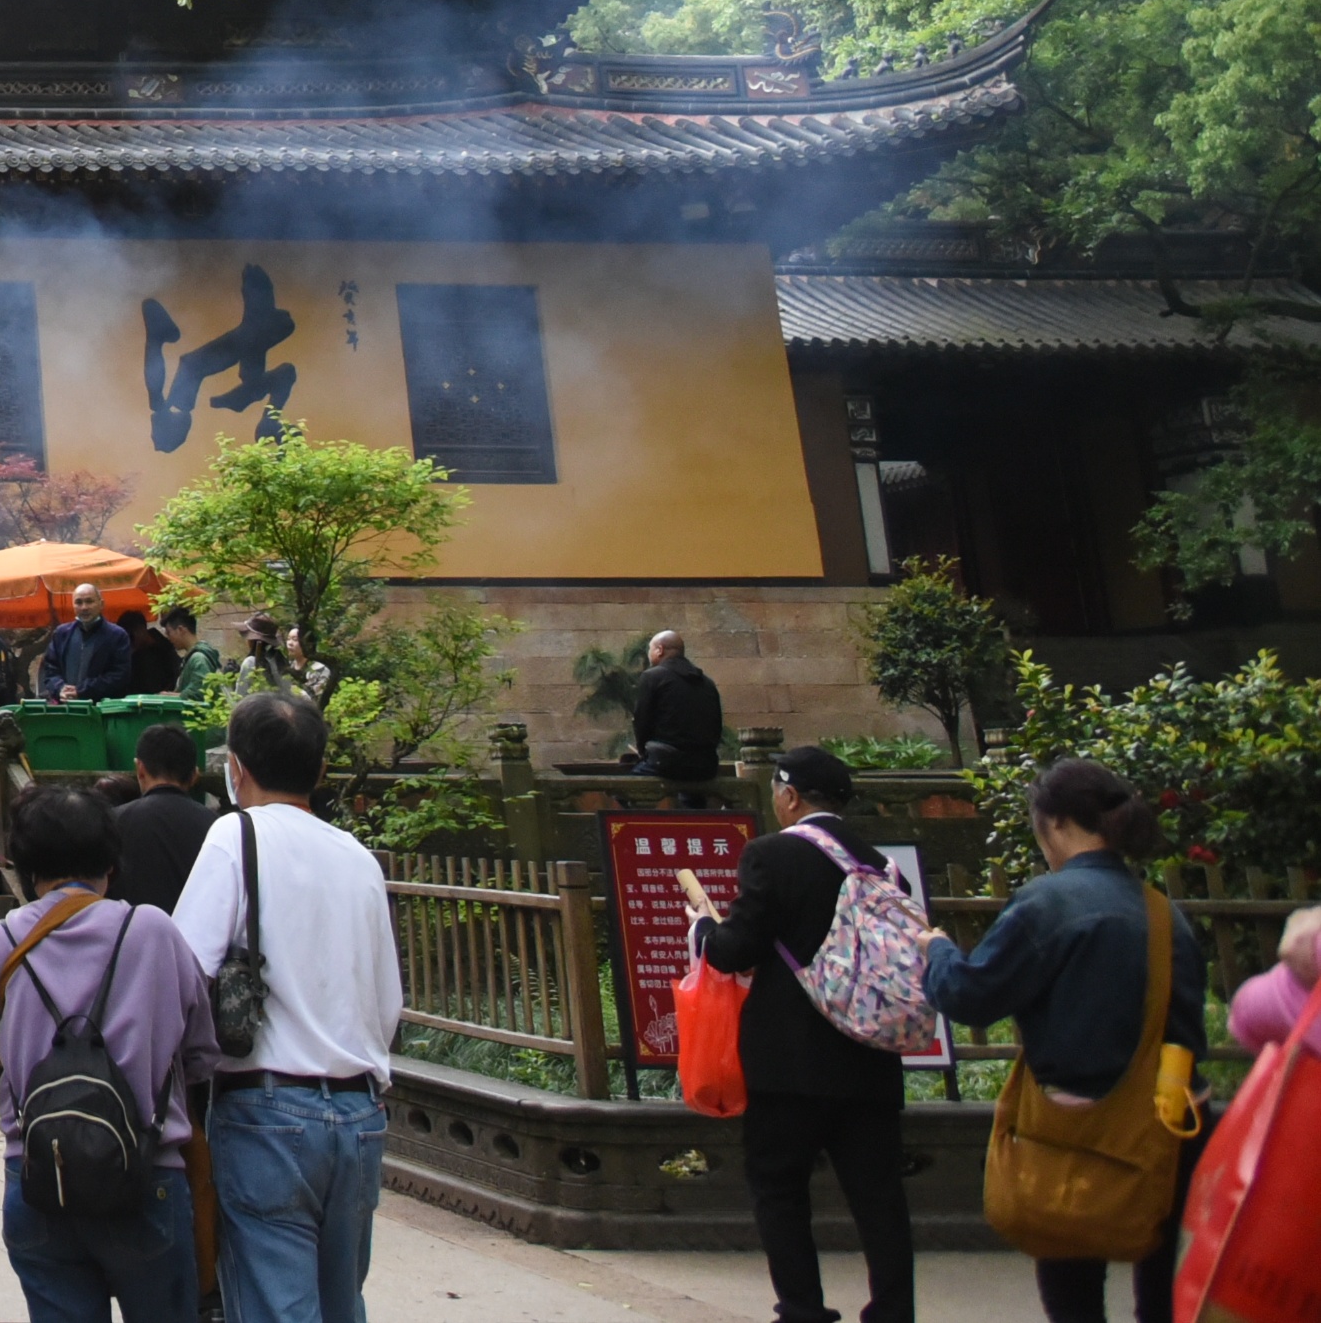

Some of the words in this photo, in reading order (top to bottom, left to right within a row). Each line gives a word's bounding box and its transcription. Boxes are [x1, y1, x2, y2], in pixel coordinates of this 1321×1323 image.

[141, 262, 303, 464] 法
[634, 837, 730, 856] 温馨提示
